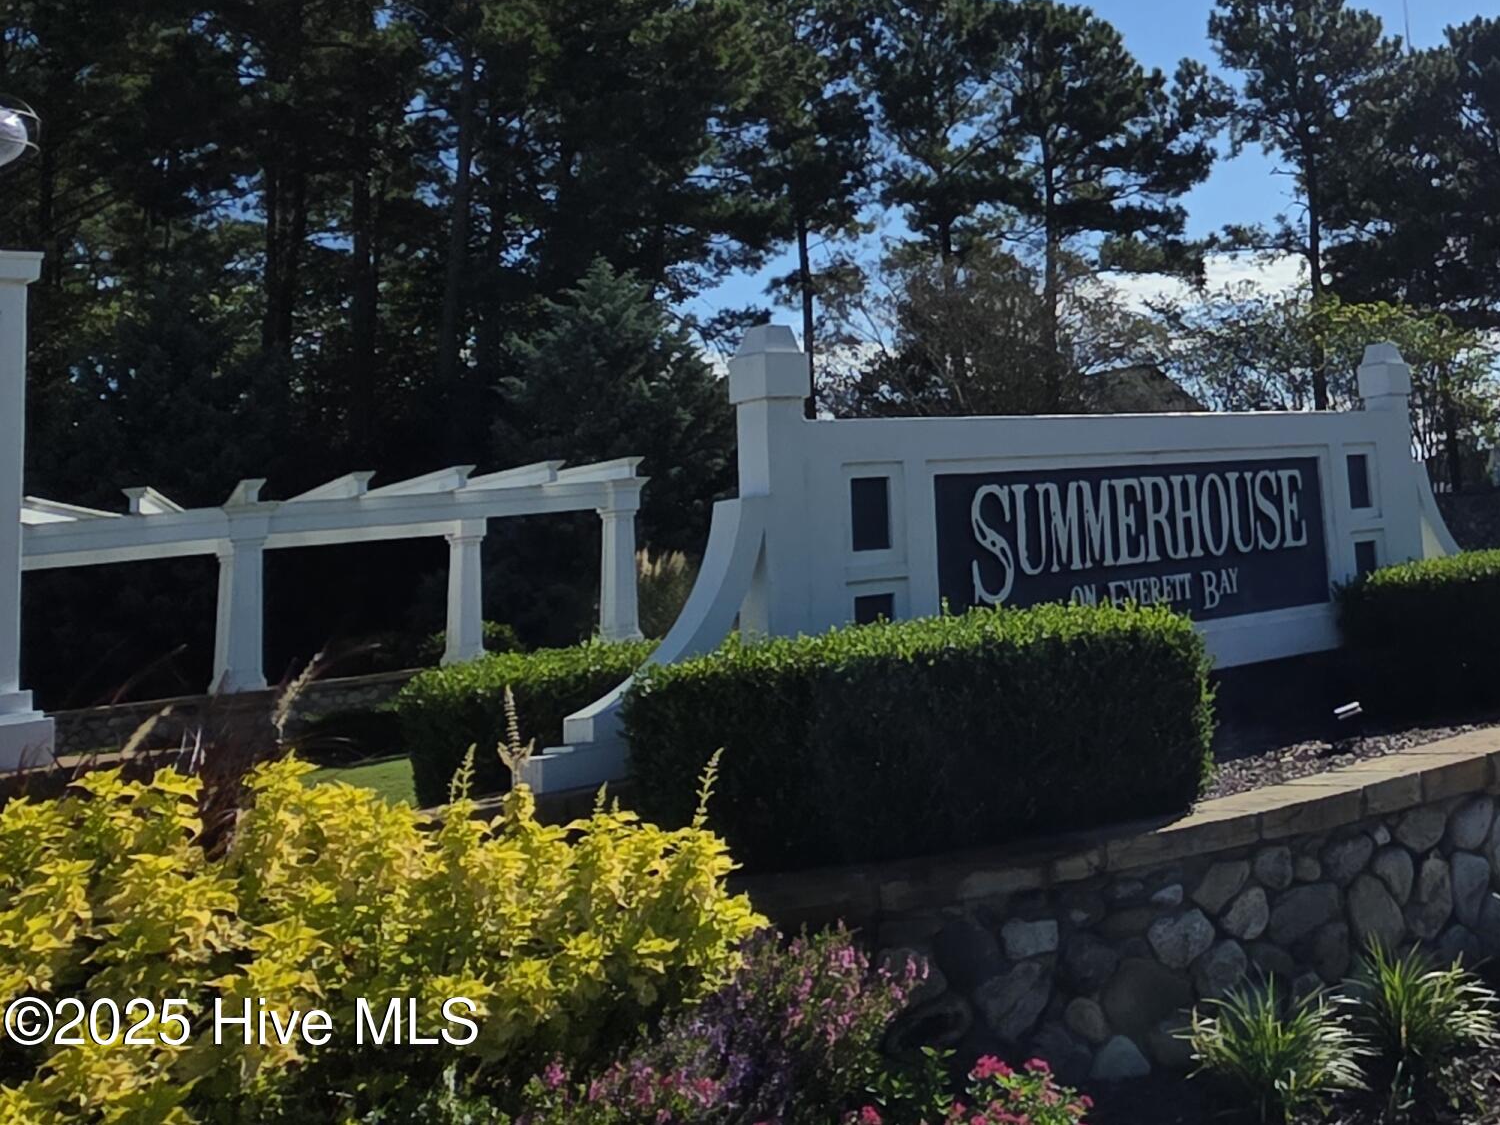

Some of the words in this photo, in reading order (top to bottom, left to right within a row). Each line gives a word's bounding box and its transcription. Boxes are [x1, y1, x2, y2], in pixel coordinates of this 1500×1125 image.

[971, 469, 1307, 604] SUMMERHOUSE
[1070, 584, 1097, 609] ON
[1107, 573, 1192, 614] EVERETT
[1201, 567, 1239, 610] BAY
